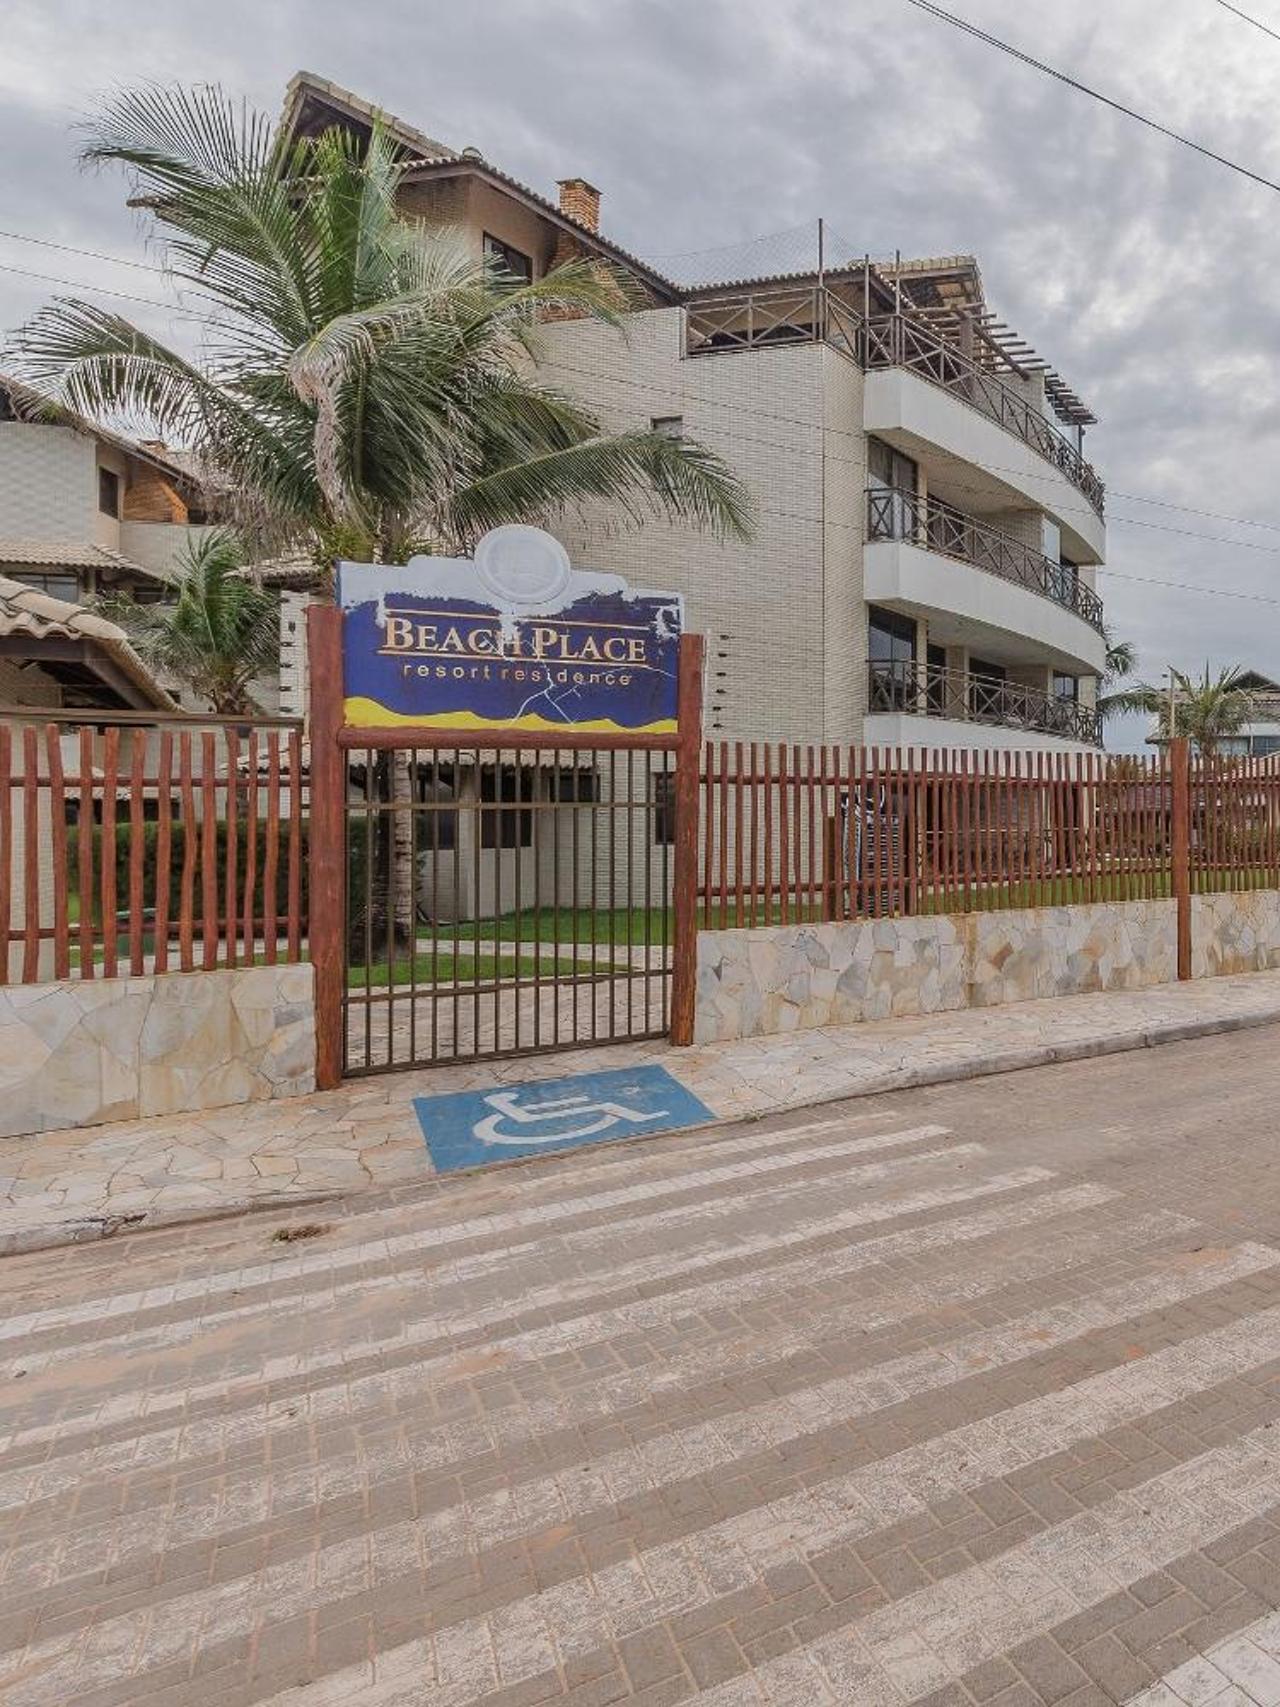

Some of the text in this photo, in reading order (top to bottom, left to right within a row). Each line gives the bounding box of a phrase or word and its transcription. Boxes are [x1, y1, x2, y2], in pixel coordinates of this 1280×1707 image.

[382, 617, 646, 662] BEACH PLACE
[403, 664, 631, 685] resort resdence
